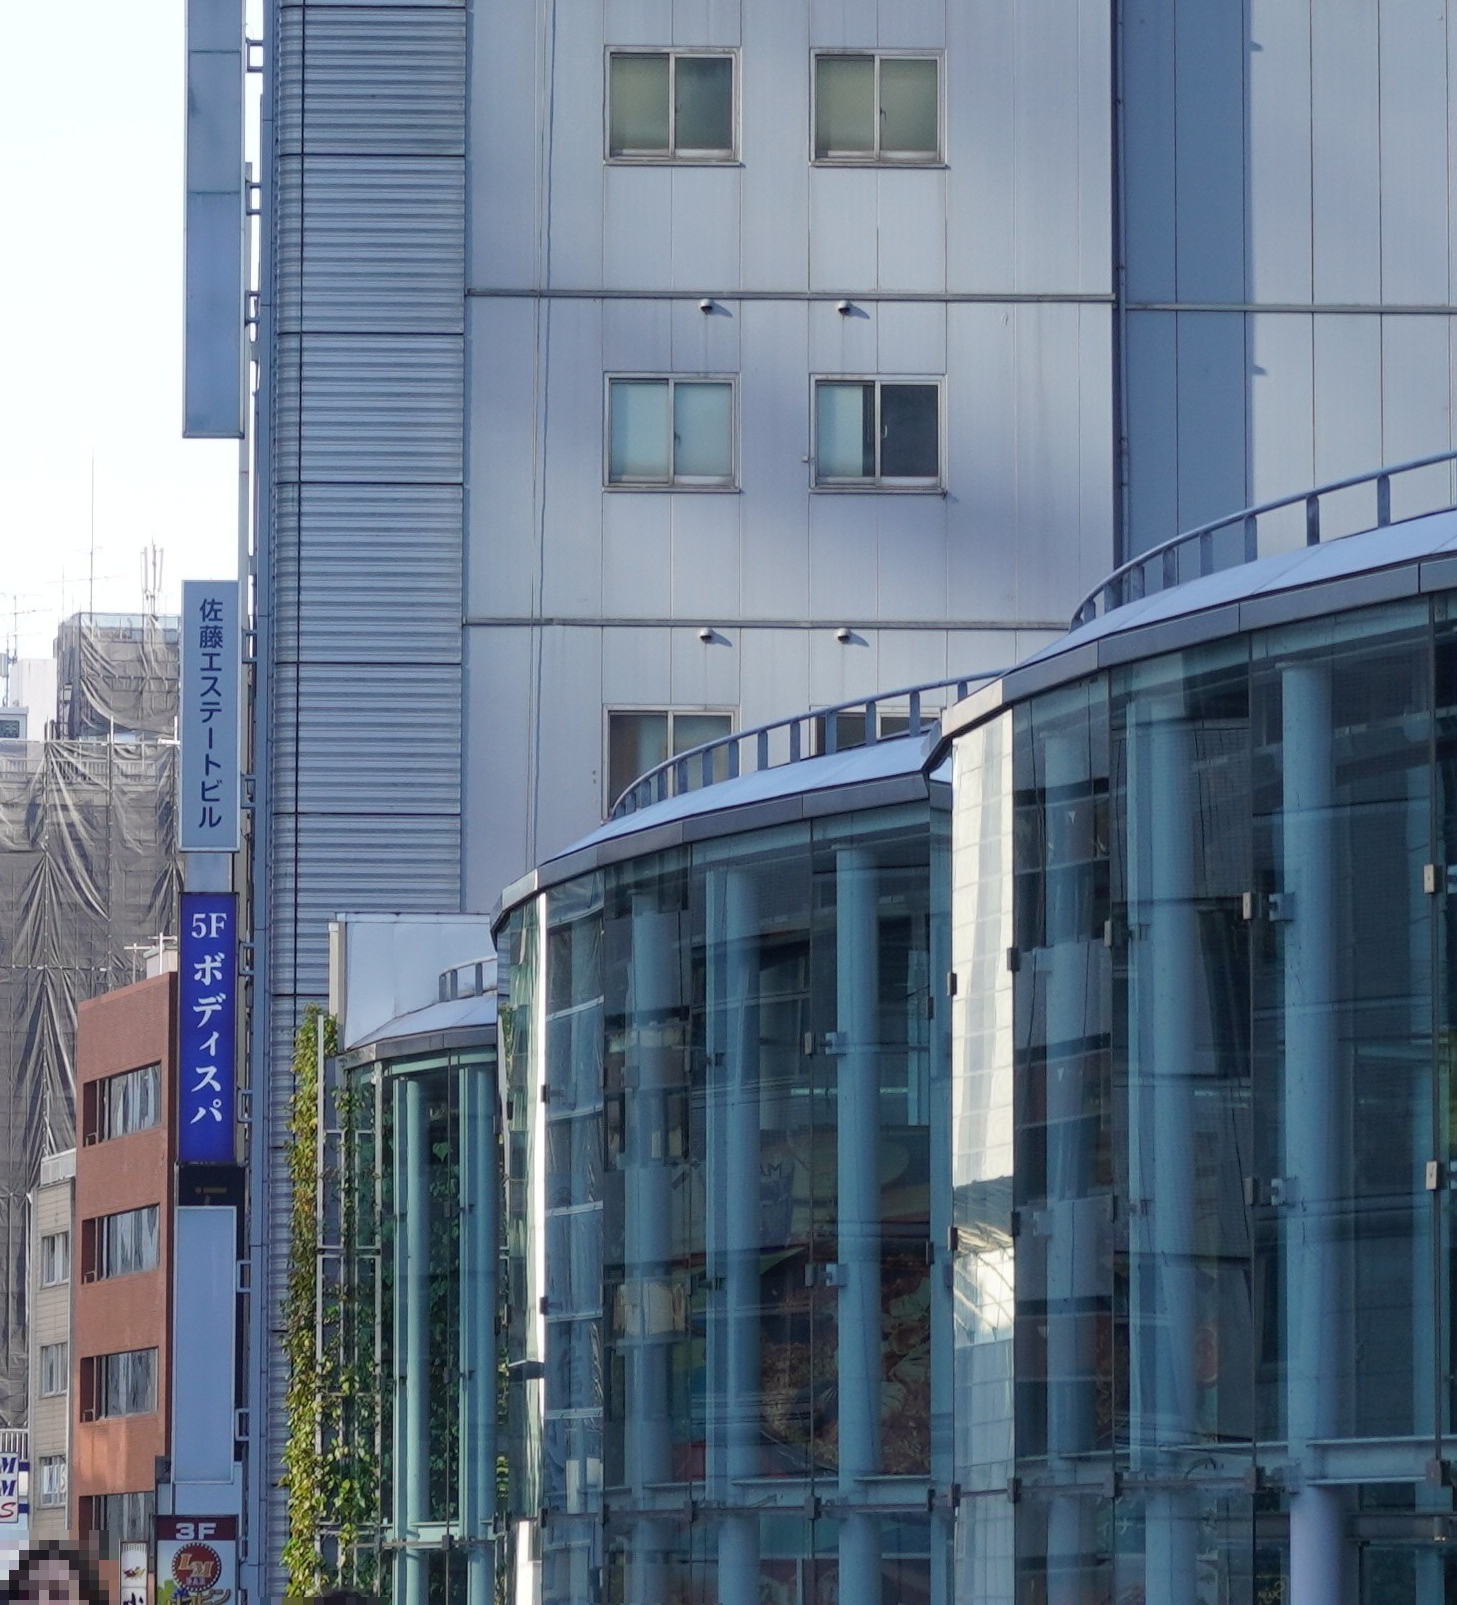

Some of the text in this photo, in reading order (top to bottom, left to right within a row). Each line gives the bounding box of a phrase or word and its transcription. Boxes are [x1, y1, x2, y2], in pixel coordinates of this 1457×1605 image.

[198, 597, 224, 829] 佐藤エステートビル
[191, 912, 227, 939] 5F
[190, 952, 226, 1124] ボディスパ
[175, 1522, 217, 1541] 3F
